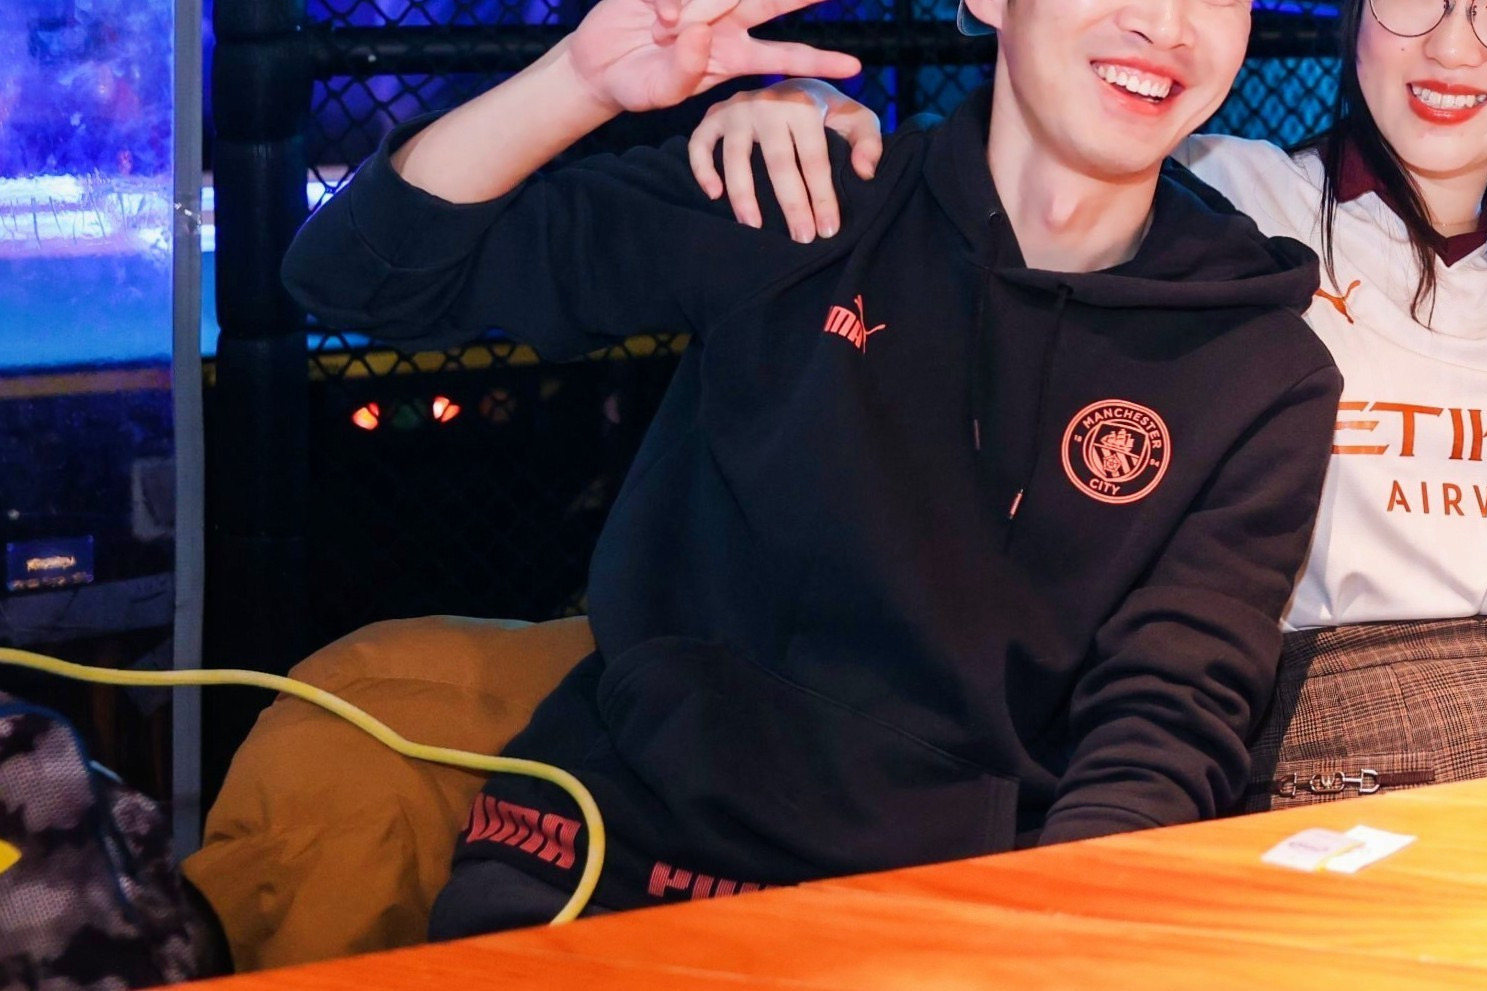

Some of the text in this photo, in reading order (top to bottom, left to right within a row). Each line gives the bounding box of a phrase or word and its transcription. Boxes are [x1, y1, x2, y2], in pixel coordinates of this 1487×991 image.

[1082, 408, 1162, 449] MANCHESTER
[1089, 478, 1120, 496] CITY
[463, 792, 581, 870] UMA
